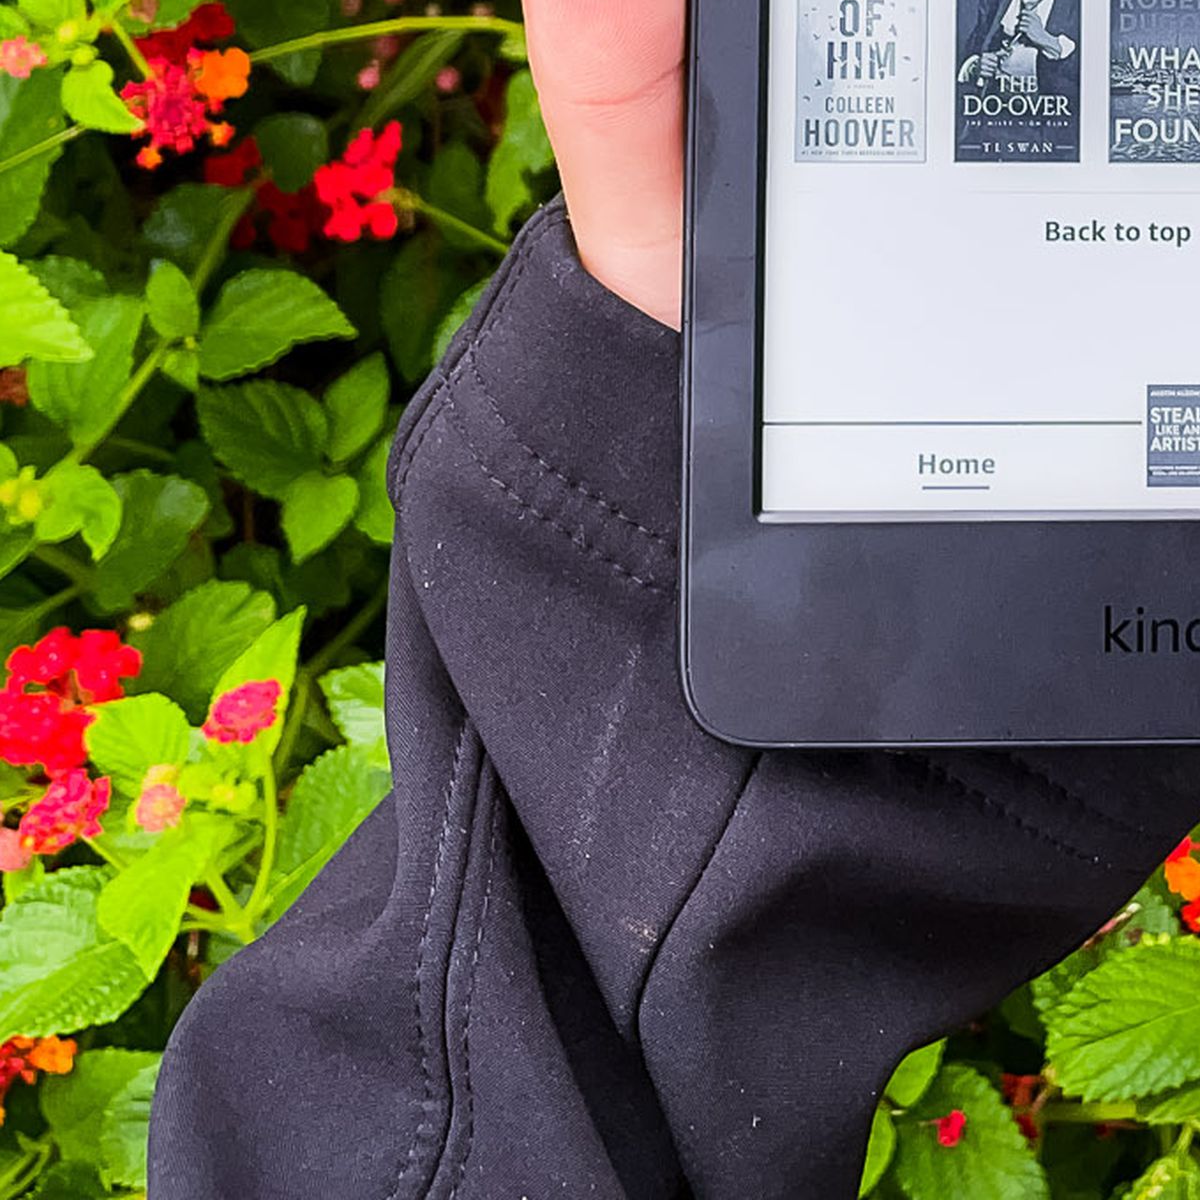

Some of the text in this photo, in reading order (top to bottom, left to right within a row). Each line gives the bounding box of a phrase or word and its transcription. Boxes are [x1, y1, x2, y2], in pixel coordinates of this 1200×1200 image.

[827, 41, 896, 80] HIM
[995, 75, 1038, 93] THE
[825, 96, 895, 114] COLLEEN
[963, 95, 1071, 116] DO-OVER
[1147, 84, 1200, 109] SHE
[804, 119, 915, 147] HOOVER
[1007, 142, 1053, 153] SWAN
[1045, 220, 1192, 247] Back to top
[1155, 425, 1200, 436] LIKE AN
[918, 453, 996, 475] Home
